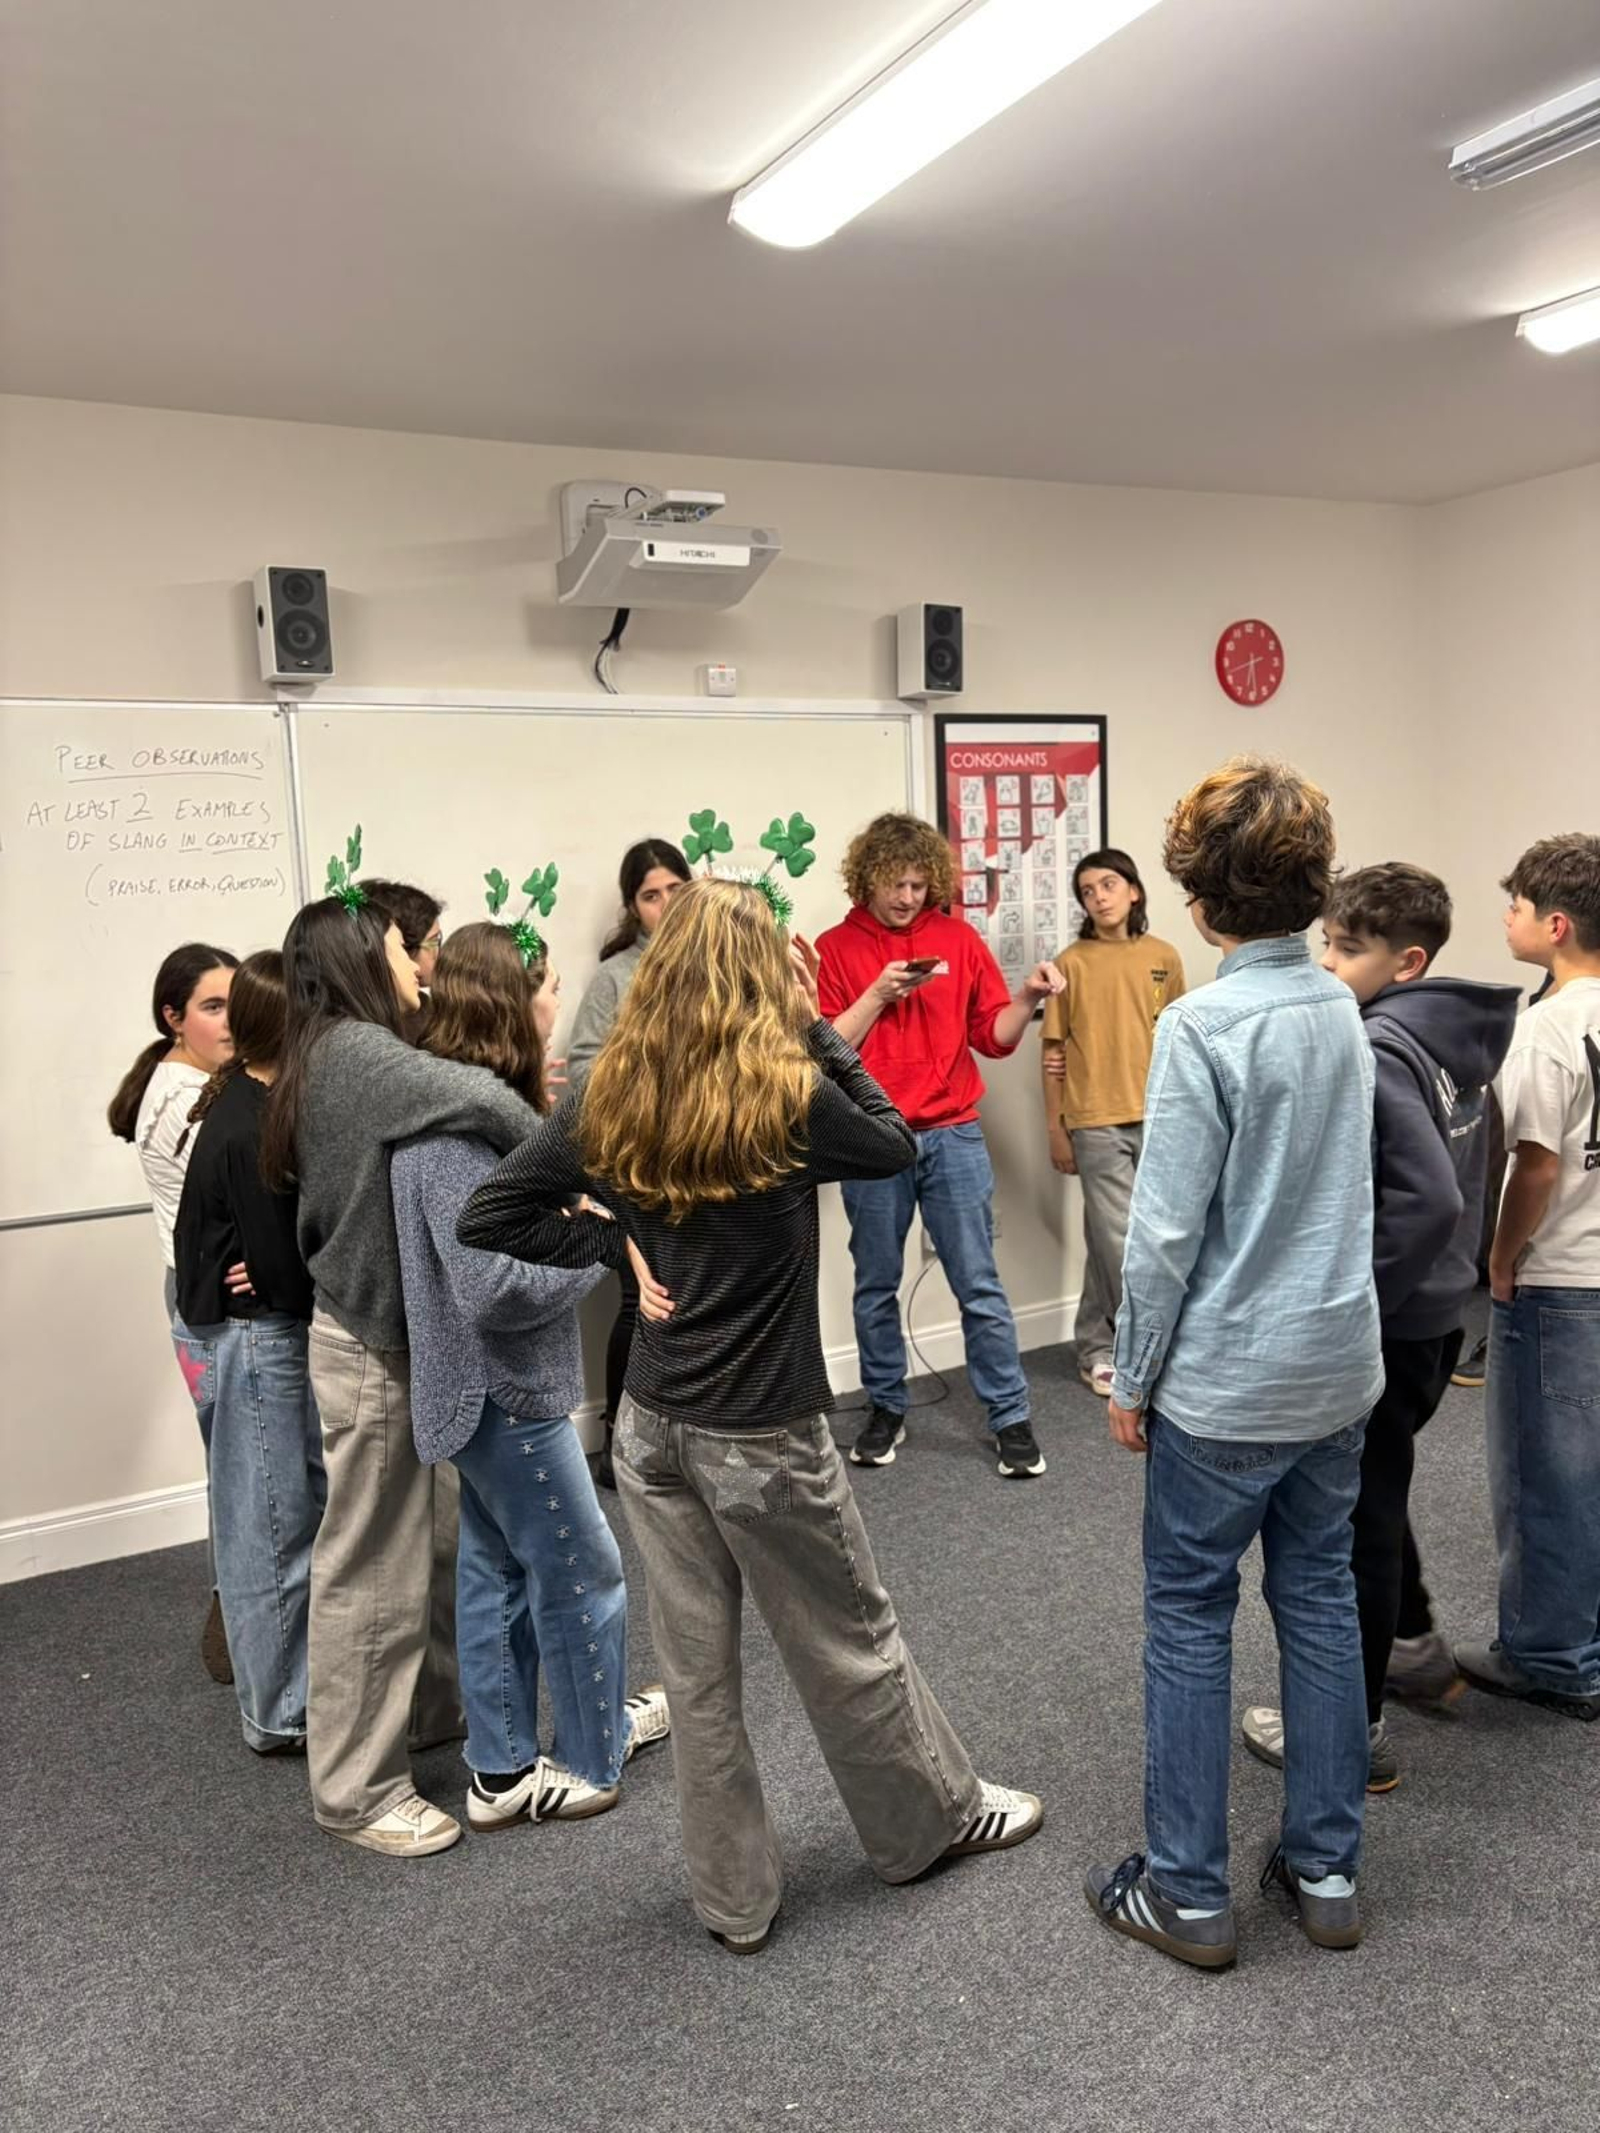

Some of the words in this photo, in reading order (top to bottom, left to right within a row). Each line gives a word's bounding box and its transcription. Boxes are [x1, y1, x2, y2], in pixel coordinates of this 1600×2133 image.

[680, 549, 716, 558] HITACHI
[55, 745, 115, 773] PEER
[131, 748, 264, 770] OBSERVATIONS
[950, 751, 1048, 769] CONSONANTS
[27, 802, 55, 826] AT
[64, 798, 120, 823] LEAST
[132, 793, 151, 816] 2
[174, 799, 271, 824] EXAMPLES
[67, 831, 95, 850] OF
[109, 832, 167, 851] SLANG
[181, 832, 196, 846] IN
[205, 832, 284, 850] CONTEXT
